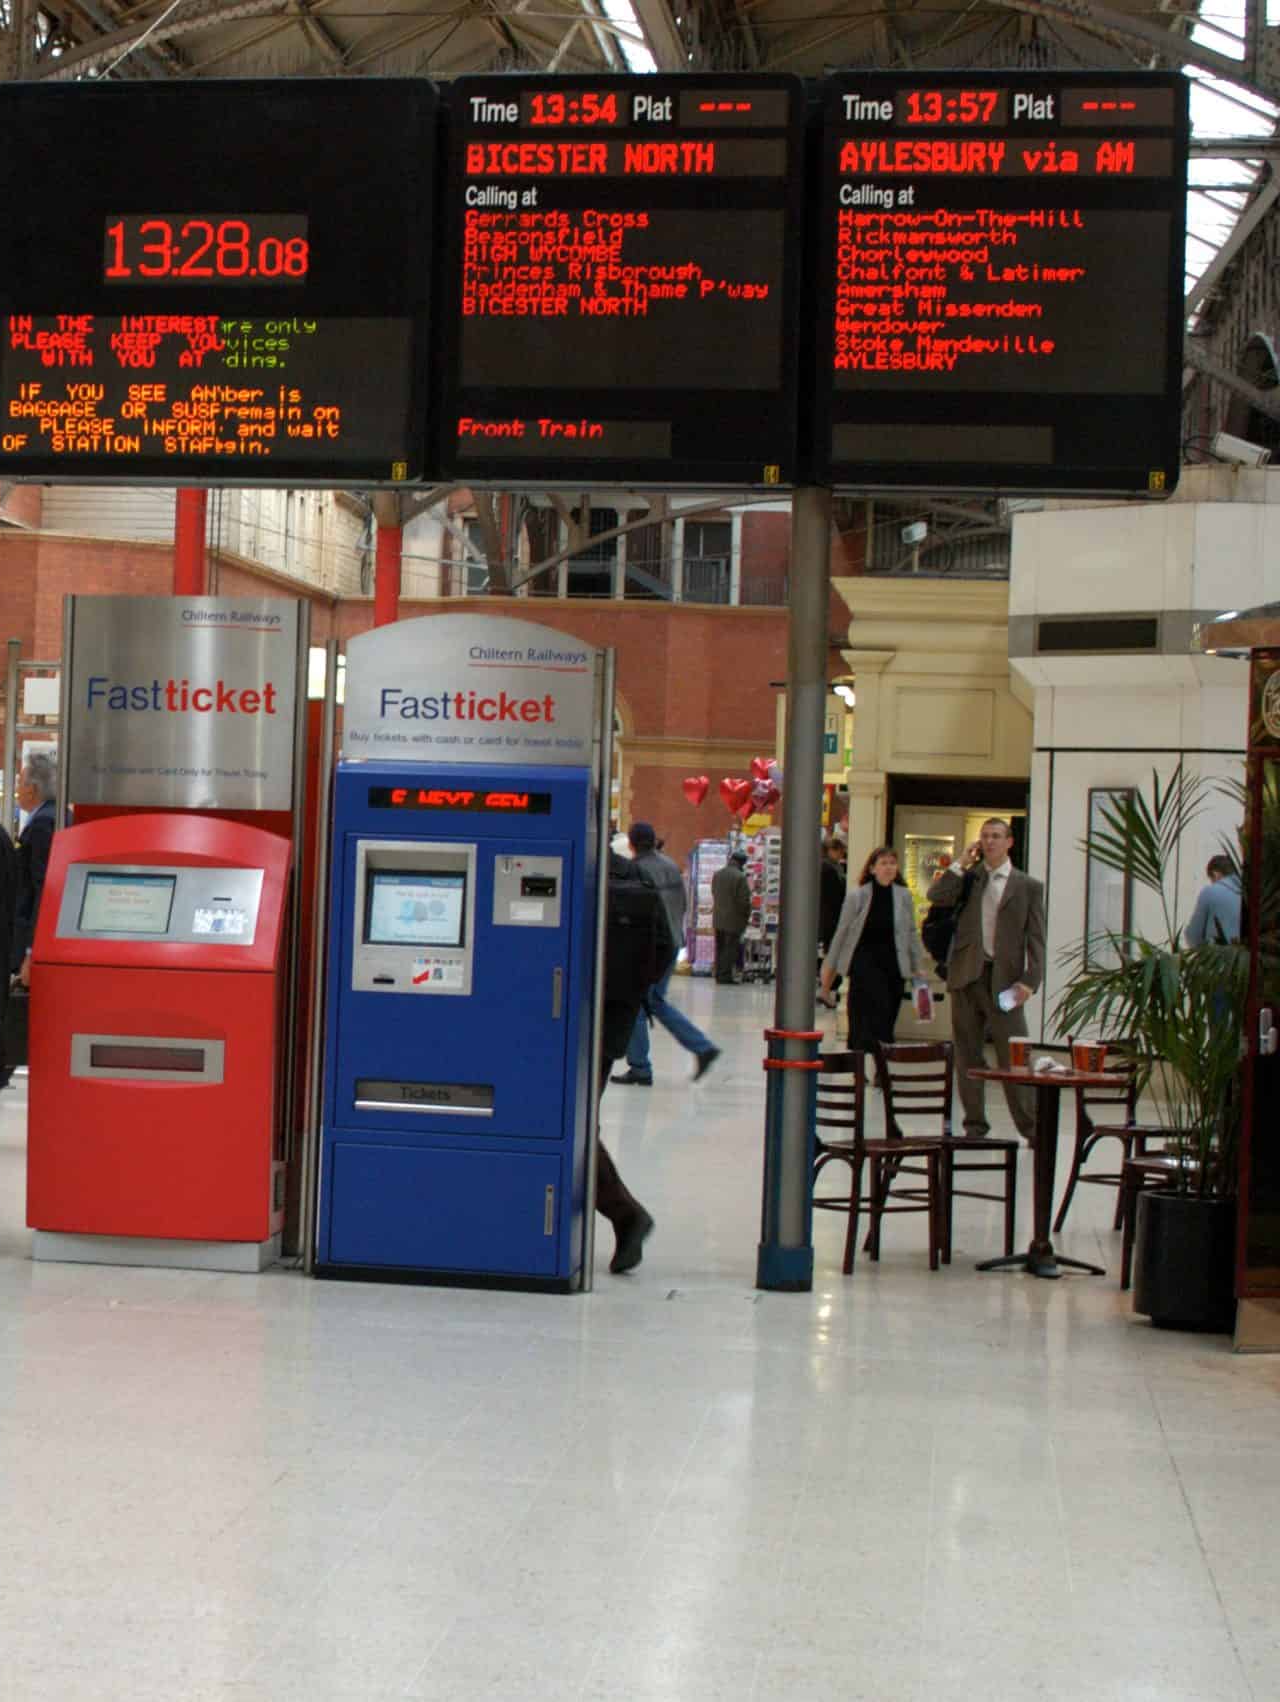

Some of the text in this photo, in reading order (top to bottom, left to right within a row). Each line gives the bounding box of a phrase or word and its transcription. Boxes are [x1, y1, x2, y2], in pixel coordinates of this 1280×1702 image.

[470, 94, 672, 125] Time 13:54 Plat
[842, 91, 1054, 124] Time 13:57 Plat
[466, 143, 715, 174] BICESTER NORTH
[839, 141, 1135, 173] AYLESBURY via AM
[465, 186, 537, 209] Calling at
[839, 184, 915, 208] Calling at
[582, 210, 649, 228] Cross
[464, 228, 623, 245] Beaconsfield
[838, 228, 1017, 245] Rickmansworth
[464, 244, 622, 262] HIGH WYCOMBE
[837, 245, 989, 263] Chorleywood
[568, 262, 702, 280] Risborough
[837, 263, 947, 281] Chalfont
[986, 264, 1085, 281] Latimer
[463, 280, 581, 298] Haddenham
[620, 280, 688, 298] Thame
[836, 282, 947, 299] Amersham
[463, 298, 648, 316] BICESTER NORTH
[835, 299, 1042, 318] Great Missenden
[9, 315, 316, 334] IN THE INTEREST only
[835, 317, 945, 334] Wendover
[11, 332, 86, 349] PLEASE
[111, 332, 161, 349] KEEP
[835, 335, 1055, 354] Stoke Mandeville
[41, 349, 93, 367] WITH
[116, 350, 155, 367] YOU
[179, 350, 206, 368] AT
[834, 352, 958, 371] AYLESBURY
[20, 383, 302, 402] IF YOU SEE is
[9, 400, 97, 417] BAGGAGE
[121, 401, 147, 418] OR
[313, 405, 340, 420] on
[40, 418, 340, 438] PLEASE INFORM and wait
[457, 418, 604, 438] Front Train
[2, 434, 140, 453] OF STATION
[469, 646, 587, 664] Chiltern Railways
[87, 677, 277, 714] Fastticket
[380, 688, 555, 722] Fastticket
[400, 1086, 452, 1101] Tickets
